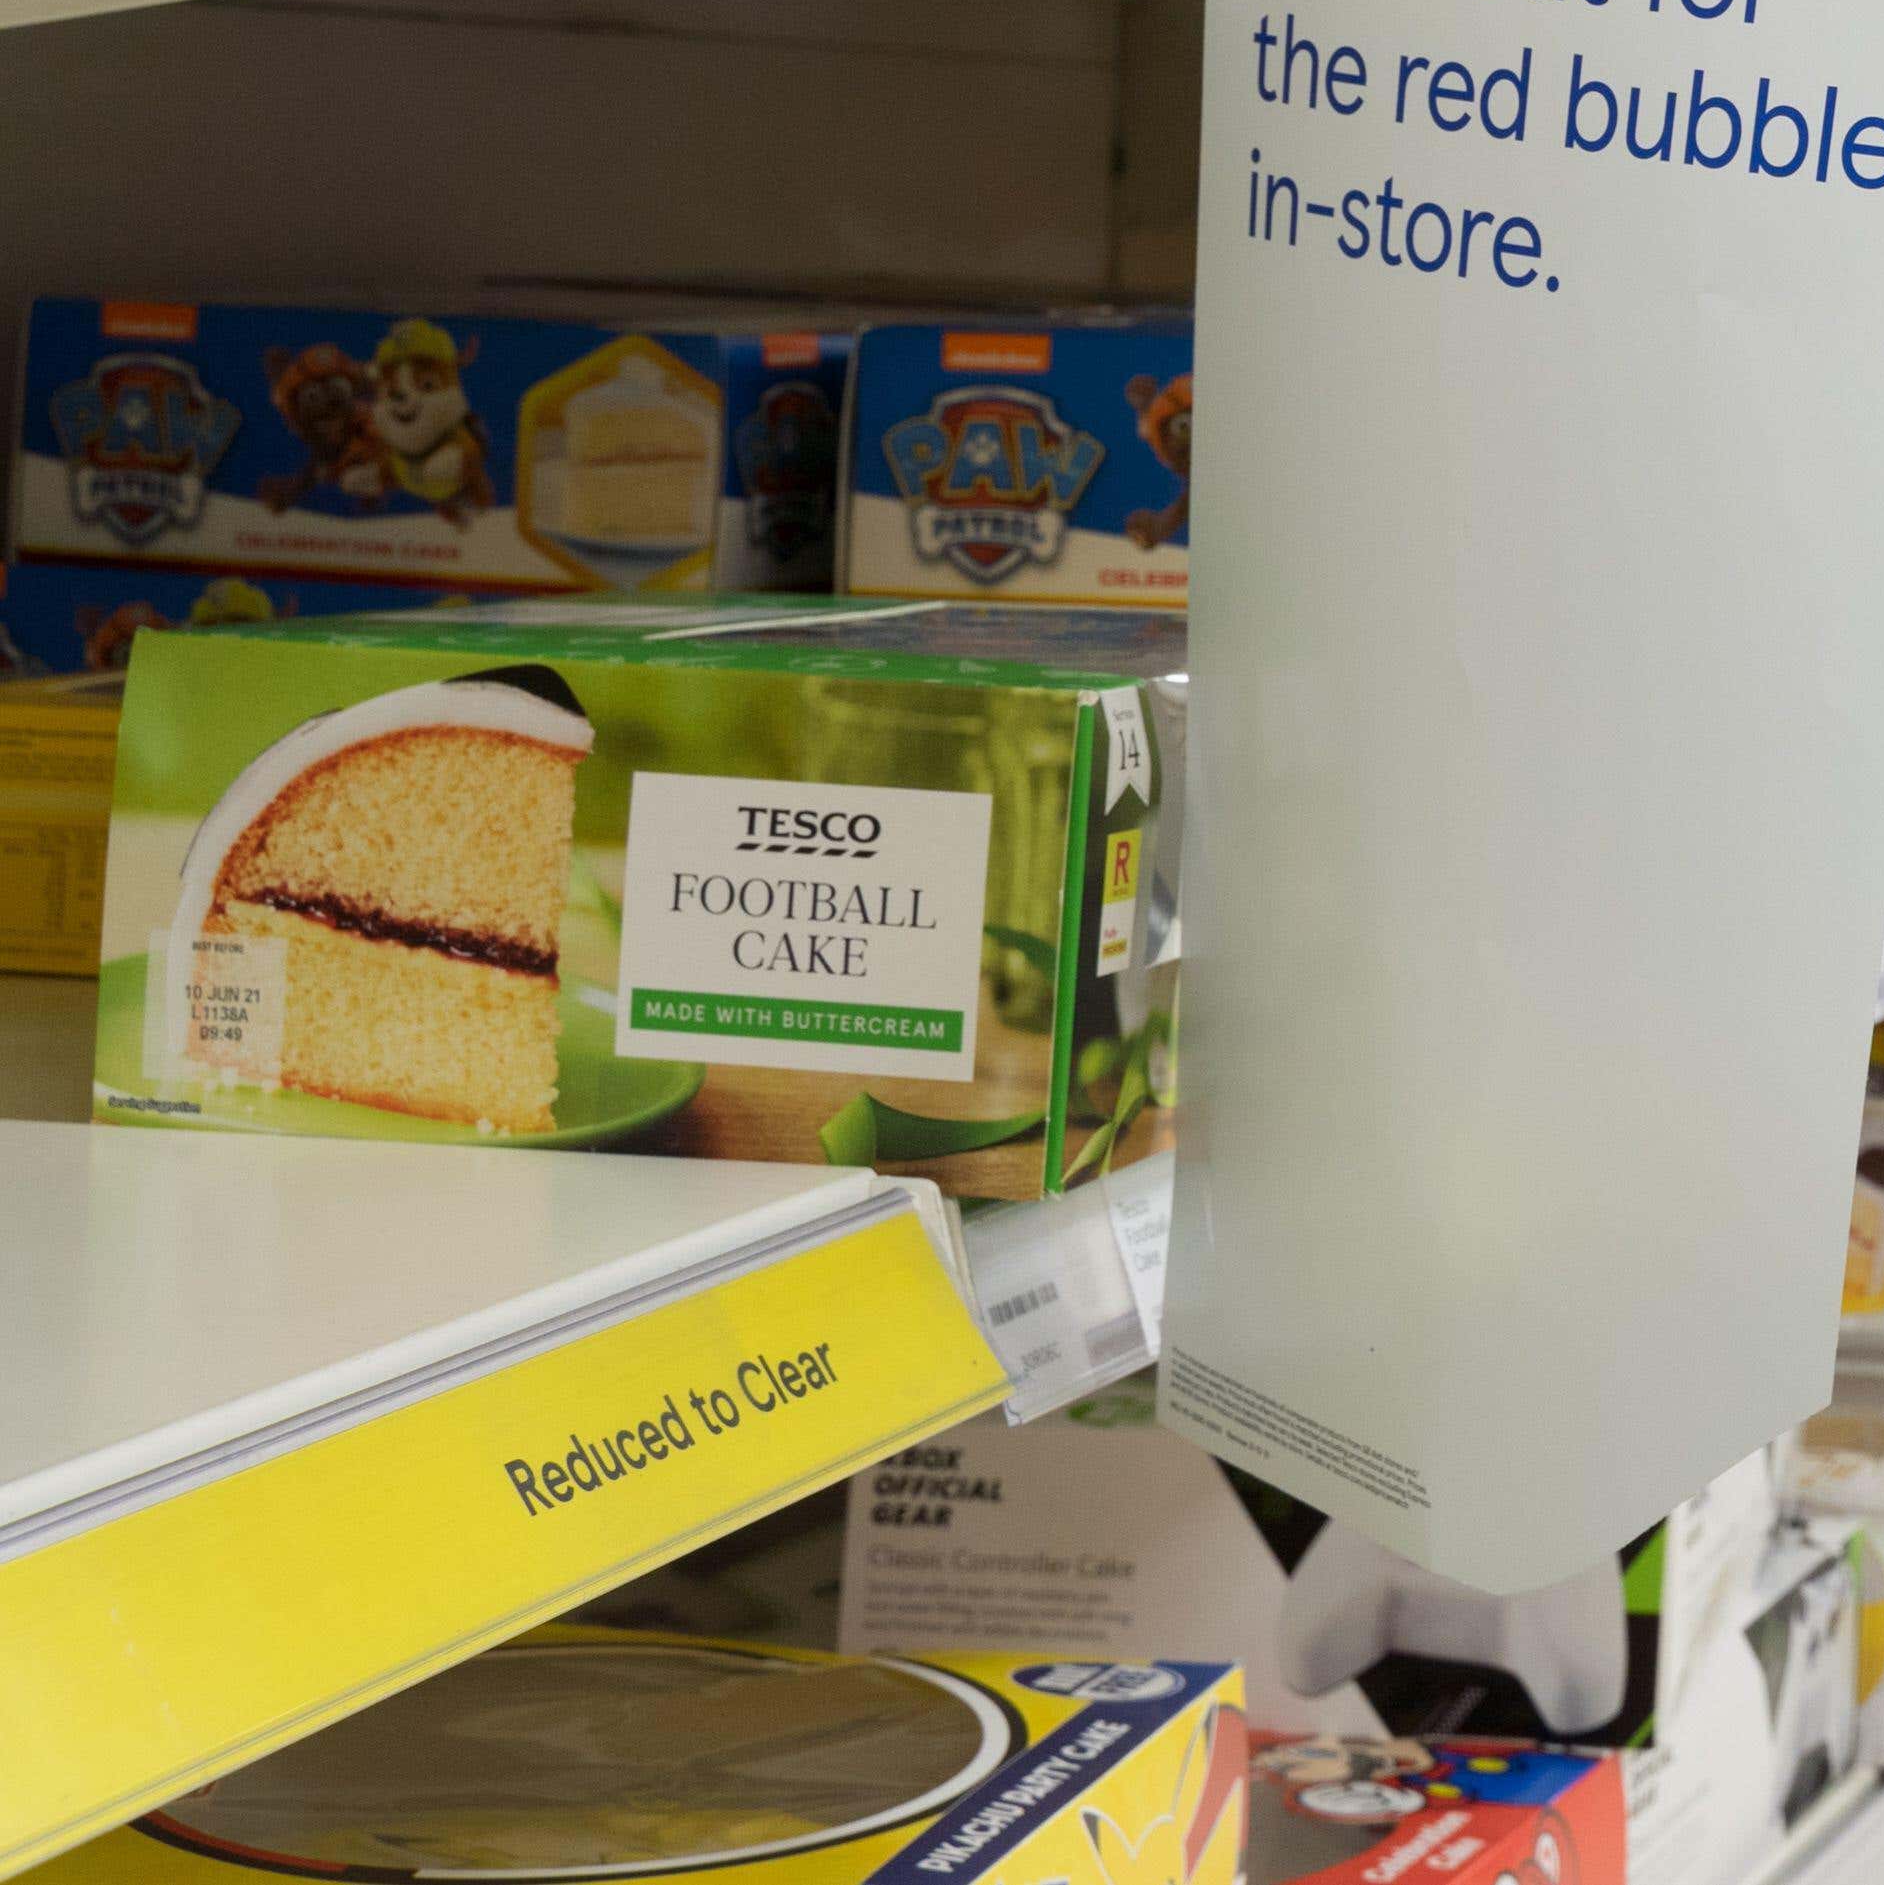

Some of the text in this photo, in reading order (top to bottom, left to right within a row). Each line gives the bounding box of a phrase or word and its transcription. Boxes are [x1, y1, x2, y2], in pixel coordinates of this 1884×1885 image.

[1253, 14, 1368, 115] the
[1395, 47, 1533, 142] red
[1248, 148, 1561, 293] in-store.
[884, 413, 1106, 510] PAW
[932, 515, 1044, 544] PATROL
[1118, 727, 1140, 771] 14
[738, 806, 881, 843] TESCO
[670, 873, 937, 930] FOOTBALL
[733, 929, 869, 977] CAKE
[186, 985, 261, 1003] 10 JUN 21
[645, 1001, 945, 1040] MADE WITH BUTTERCREAM
[504, 1343, 838, 1516] Reduced to Clear
[872, 1474, 1002, 1503] OFFICIAL
[871, 1502, 953, 1527] GEAR
[916, 1718, 1131, 1873] PIKACHU PARTY CAKE
